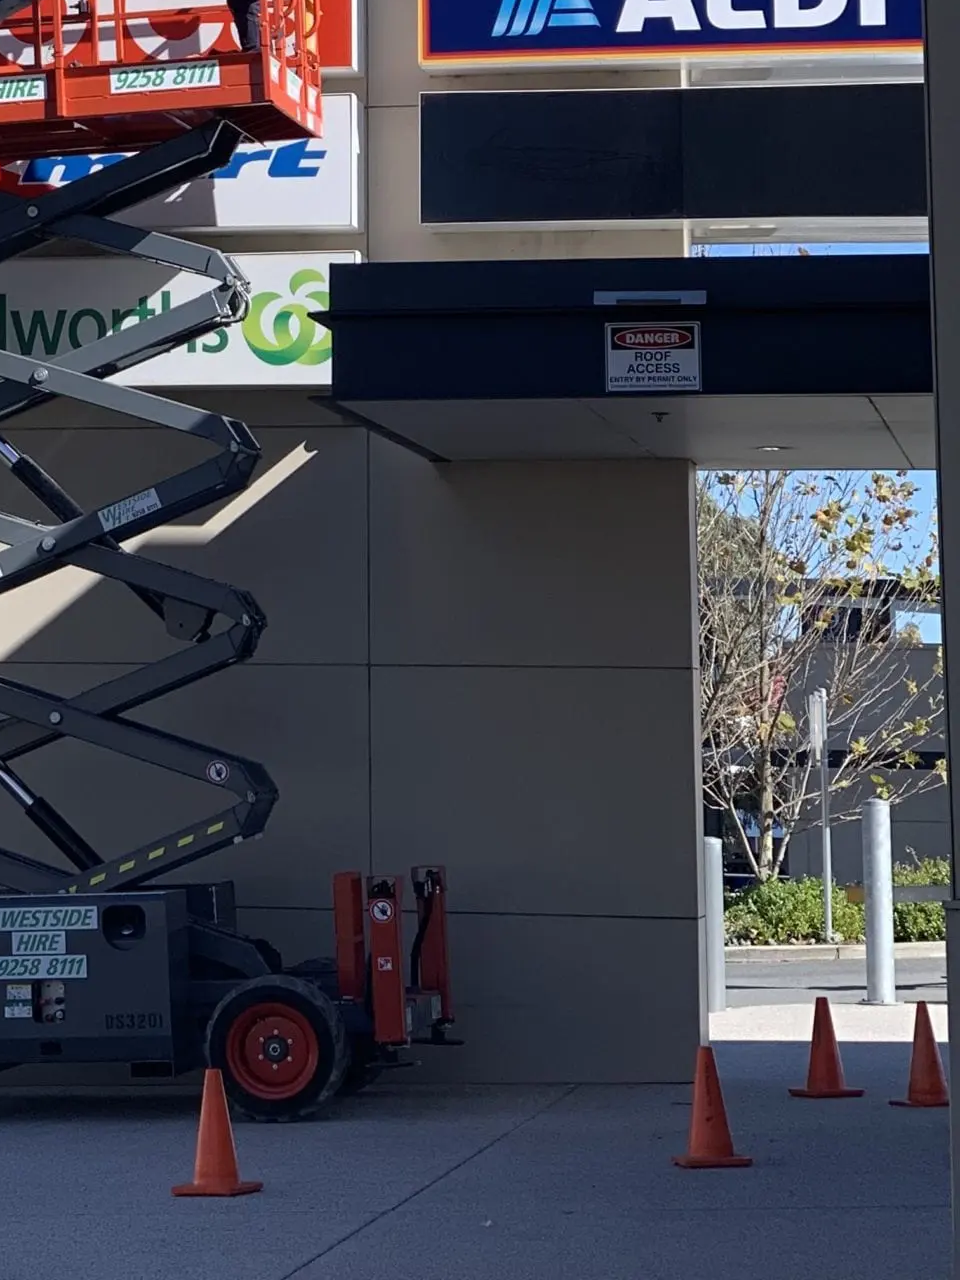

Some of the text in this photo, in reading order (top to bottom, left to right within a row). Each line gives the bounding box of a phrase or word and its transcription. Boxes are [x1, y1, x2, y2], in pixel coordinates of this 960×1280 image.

[115, 66, 165, 90] 9258
[172, 62, 217, 86] 8111
[625, 332, 680, 344] DANGER
[634, 351, 672, 362] ROOF
[627, 362, 681, 374] ACCESS
[1, 908, 94, 928] WESTSIDE
[16, 933, 62, 952] HIRE
[46, 957, 86, 976] 8111
